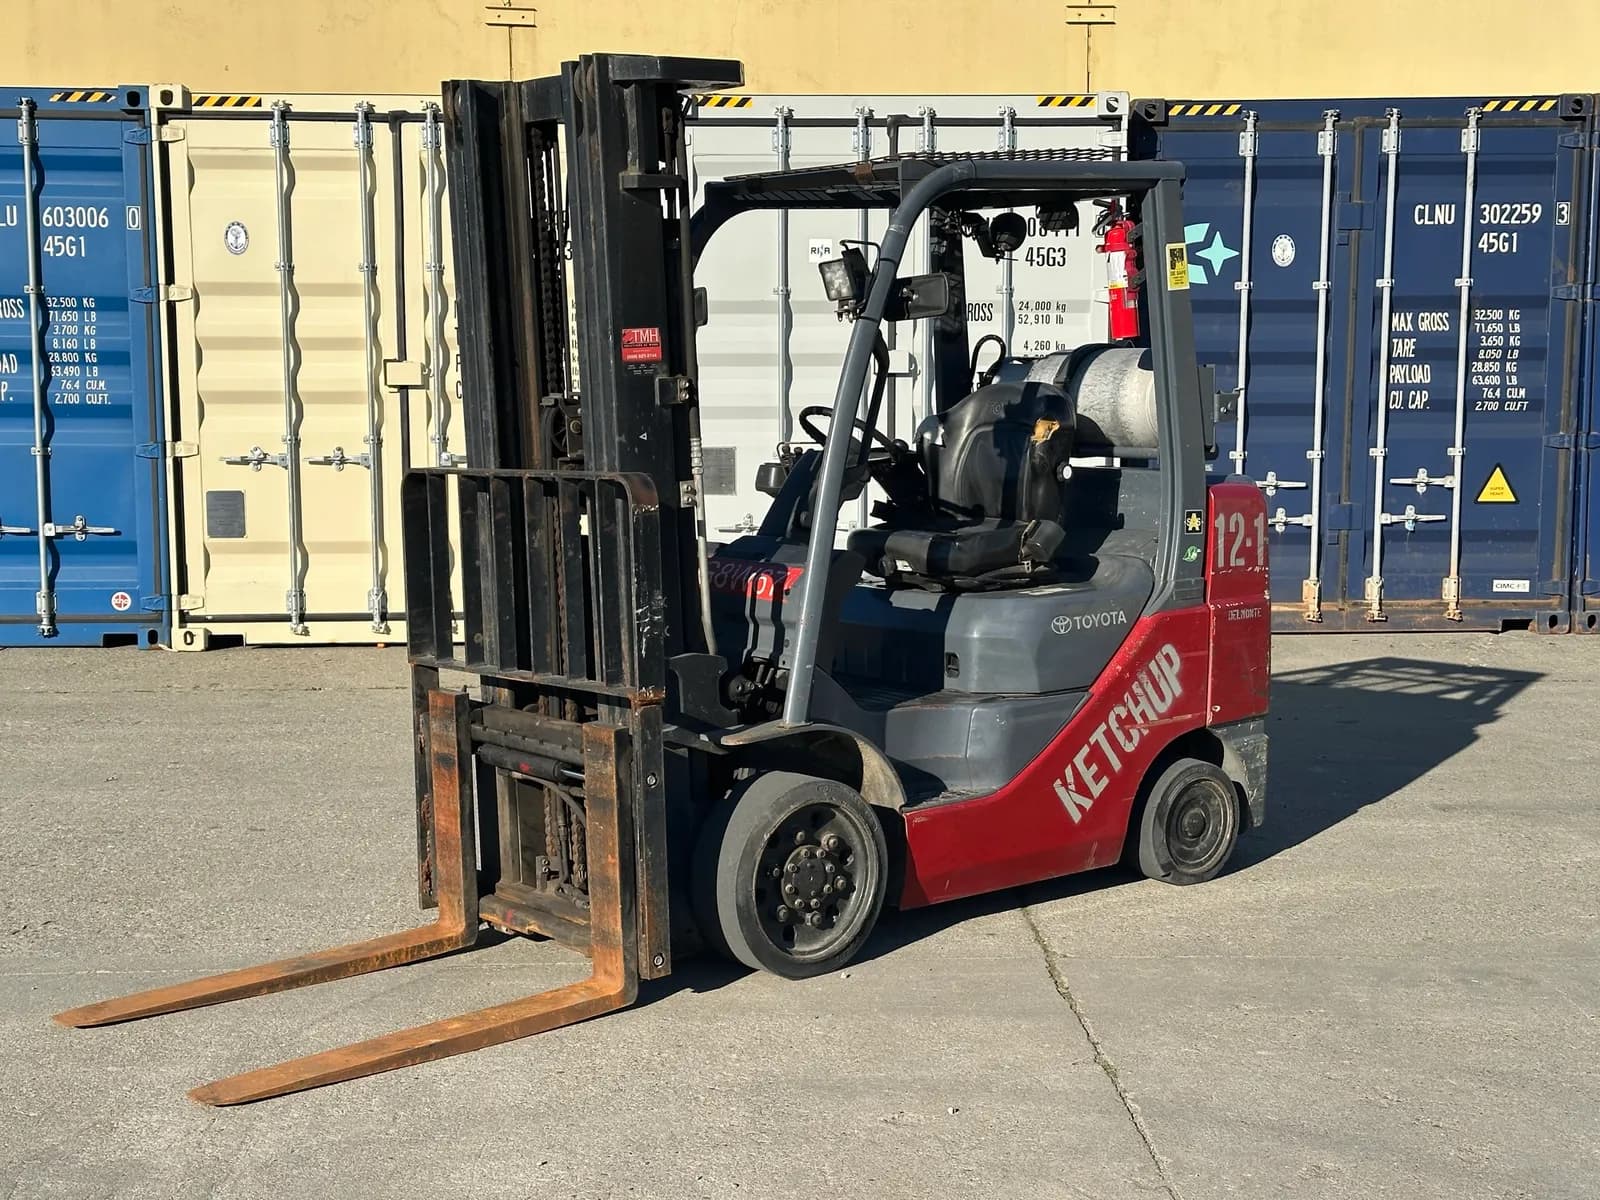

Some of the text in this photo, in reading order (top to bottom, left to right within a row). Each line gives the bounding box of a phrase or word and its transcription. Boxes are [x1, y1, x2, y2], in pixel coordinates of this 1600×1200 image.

[42, 206, 109, 228] 603006
[128, 206, 139, 229] 0
[1414, 203, 1569, 225] CLNU 302259 3
[43, 235, 86, 257] 45G1
[1478, 232, 1518, 253] 45G1
[1025, 246, 1067, 267] 45G3
[46, 297, 95, 308] 32.500 KG
[1018, 301, 1067, 313] 24,000 kg
[48, 311, 97, 322] 71.650 LB
[1018, 314, 1064, 326] 52,910 lb
[1474, 309, 1520, 320] 32.500 KG
[1391, 312, 1450, 332] MAX GROSS
[53, 325, 96, 336] 3.700 KG
[1474, 323, 1520, 334] 71.650 LB
[631, 328, 659, 343] TMH
[1480, 336, 1520, 346] 3.650 KG
[53, 338, 96, 350] 8.160 LB
[1023, 340, 1051, 352] 4,260
[1392, 338, 1417, 358] TARE
[48, 352, 97, 363] 28.800 KG
[1478, 349, 1519, 359] 8.050 LB
[86, 367, 98, 377] LB
[1471, 362, 1517, 373] 28.850 KG
[1390, 364, 1431, 384] PAYLOAD
[1472, 375, 1518, 385] 63.600 LB
[61, 380, 80, 391] 76.4
[55, 393, 80, 405] 2.700
[1482, 388, 1500, 399] 76.4
[1389, 390, 1430, 410] CU. CAP.
[1475, 401, 1499, 411] 2.700
[1073, 610, 1127, 630] TOYOTA
[1228, 607, 1262, 621] DELMONTE
[1053, 643, 1183, 824] KETCHUP
